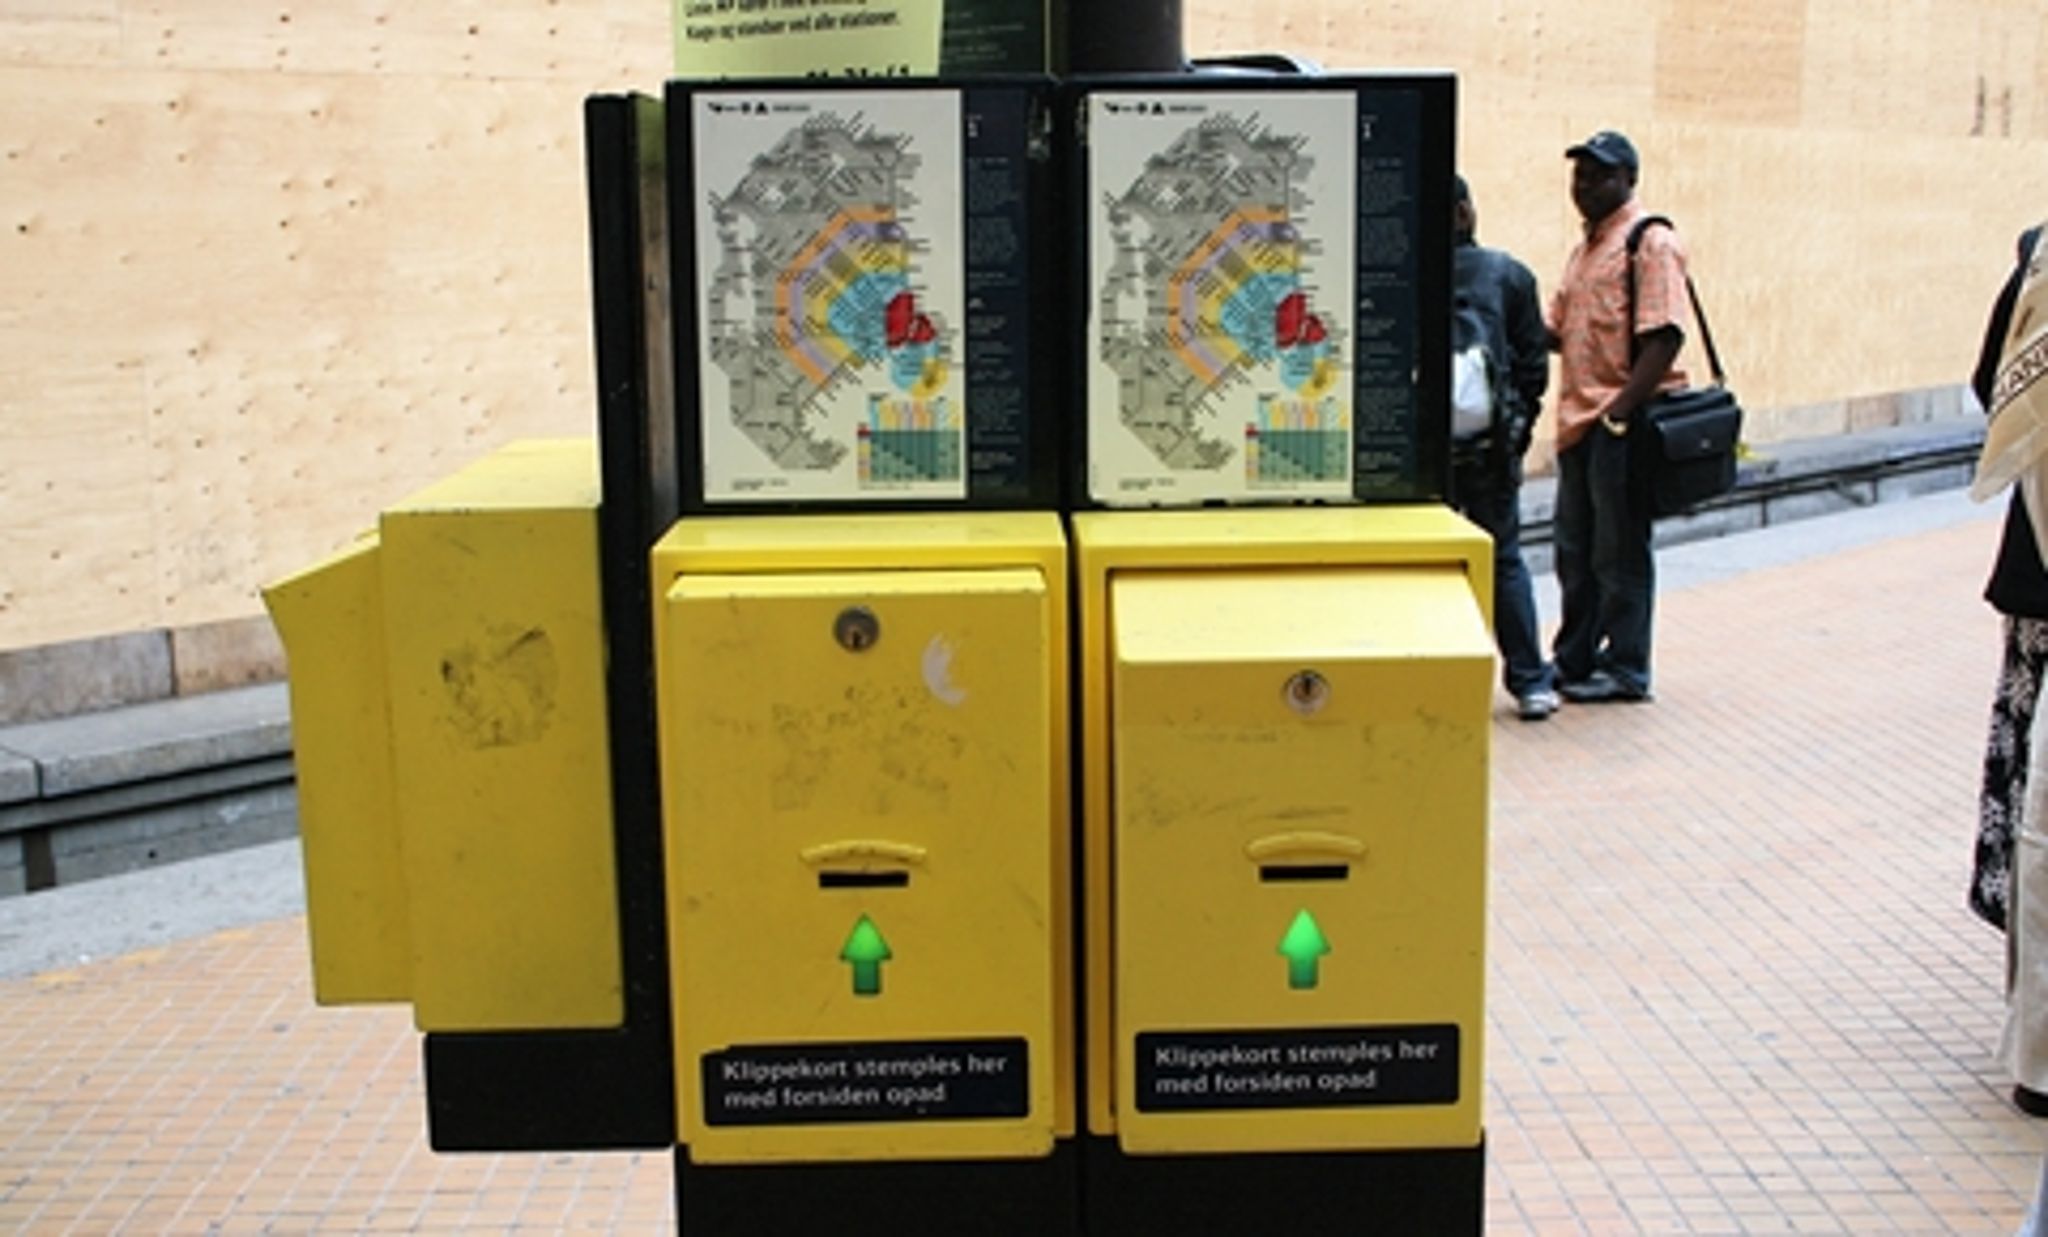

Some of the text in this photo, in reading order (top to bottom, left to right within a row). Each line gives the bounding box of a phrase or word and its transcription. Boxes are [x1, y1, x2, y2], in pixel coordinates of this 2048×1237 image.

[789, 14, 811, 31] ved
[815, 12, 837, 30] alle
[1155, 1039, 1440, 1070] Klippekort stemples her
[722, 1053, 1008, 1084] Klippekort stemples her
[1155, 1068, 1376, 1094] med forsiden opad
[723, 1081, 946, 1108] med forsiden opad
